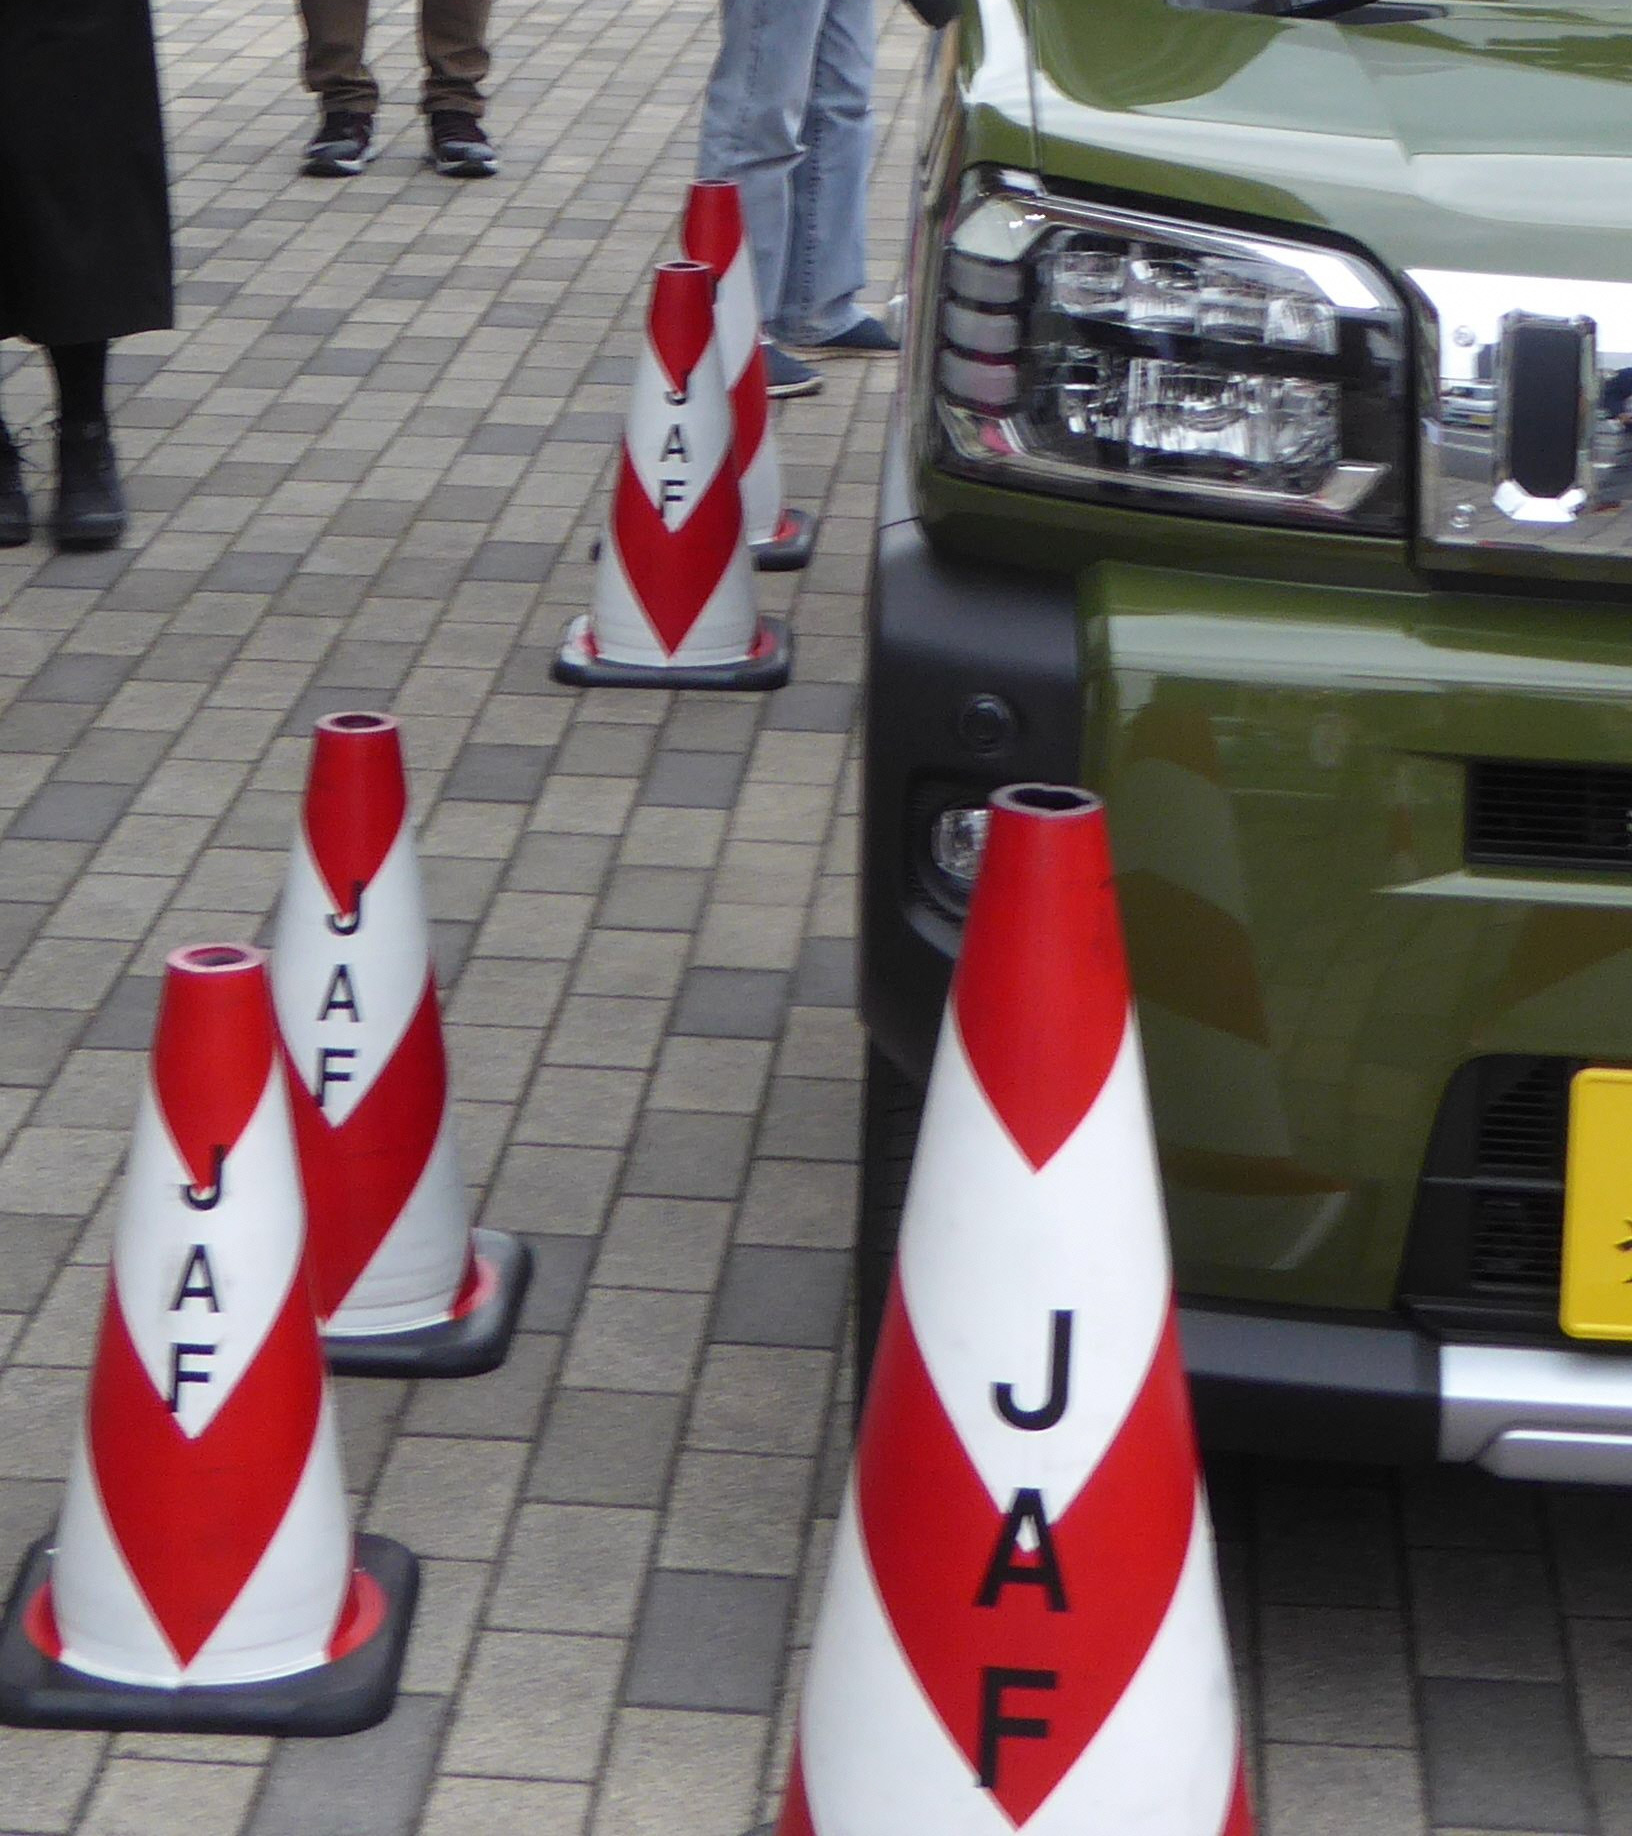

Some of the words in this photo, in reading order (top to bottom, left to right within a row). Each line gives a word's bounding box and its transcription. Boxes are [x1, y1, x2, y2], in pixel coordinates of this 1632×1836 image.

[315, 880, 363, 1107] JAF
[167, 1143, 226, 1414] JAF
[973, 1308, 1076, 1789] JAF
